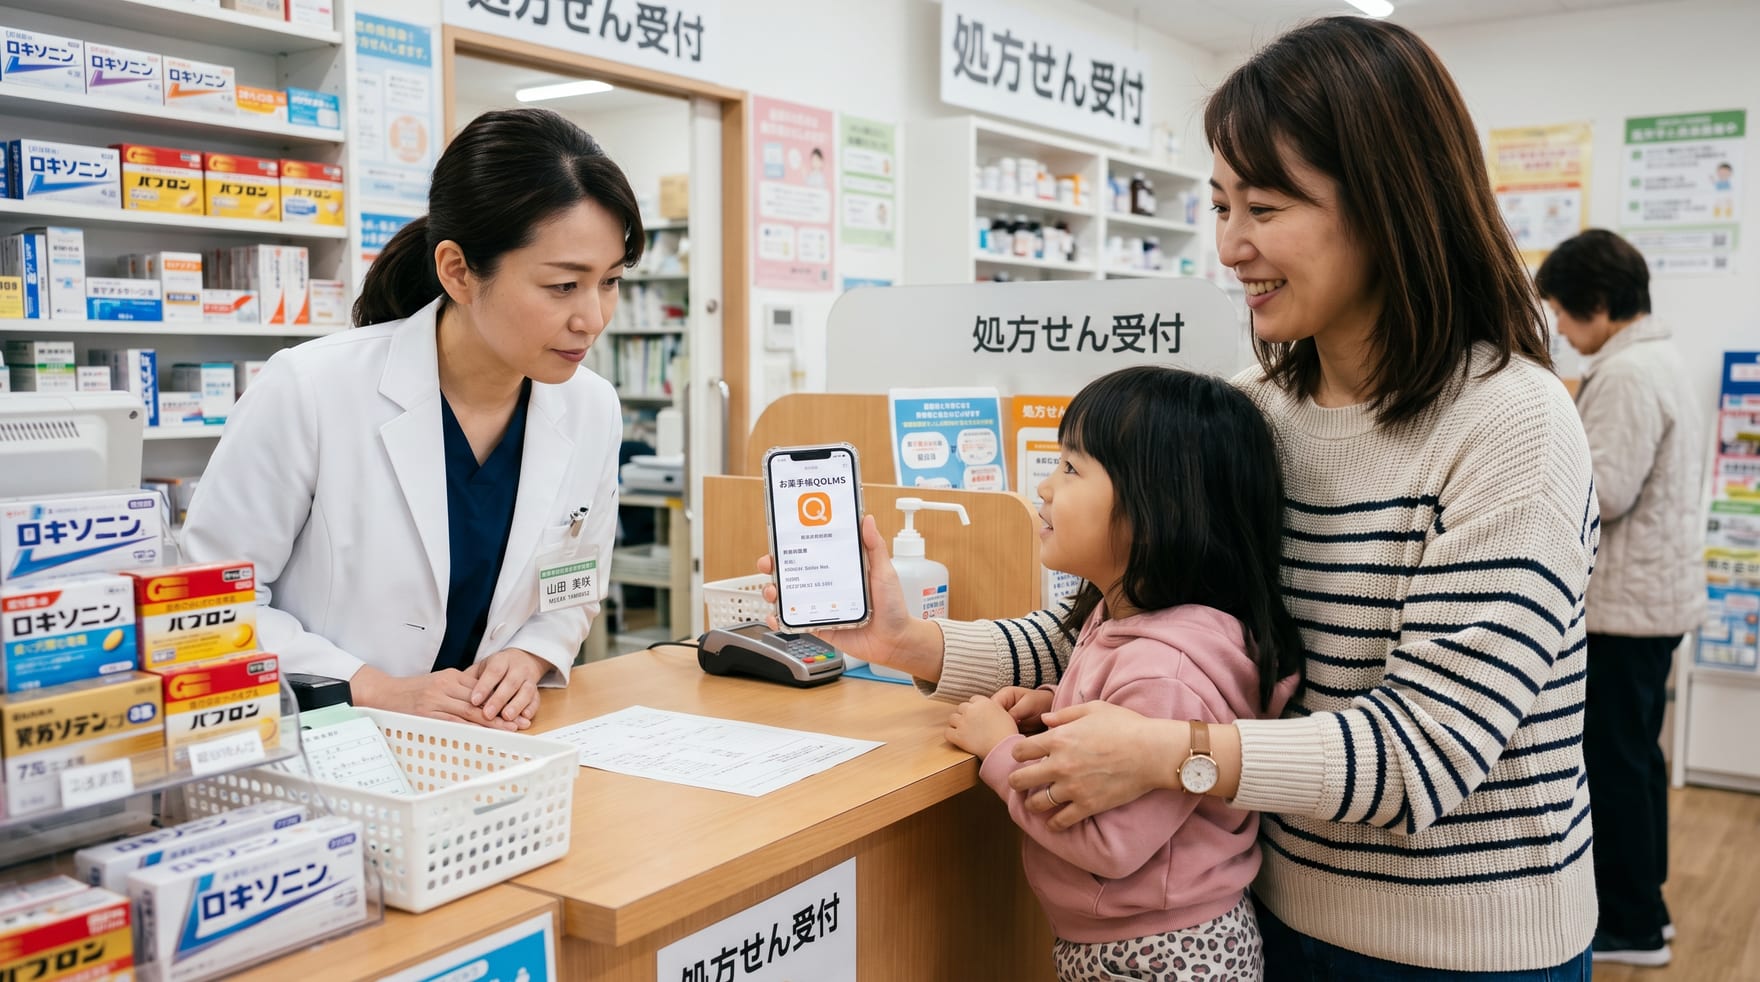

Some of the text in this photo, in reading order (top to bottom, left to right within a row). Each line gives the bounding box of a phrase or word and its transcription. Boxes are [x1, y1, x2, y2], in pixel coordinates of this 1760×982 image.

[7, 40, 74, 62] ロキソニン
[92, 55, 153, 76] ロキソニン
[169, 68, 226, 88] ロキソニン
[953, 13, 1144, 125] 処方せん受付
[30, 156, 108, 178] ロキソニン
[972, 312, 1185, 354] 処方せん受付
[17, 515, 141, 547] ロキソニン
[546, 581, 567, 595] 山田
[572, 575, 591, 591] 美咲
[12, 605, 121, 637] ロキソニン
[202, 863, 328, 920] ロキソニン
